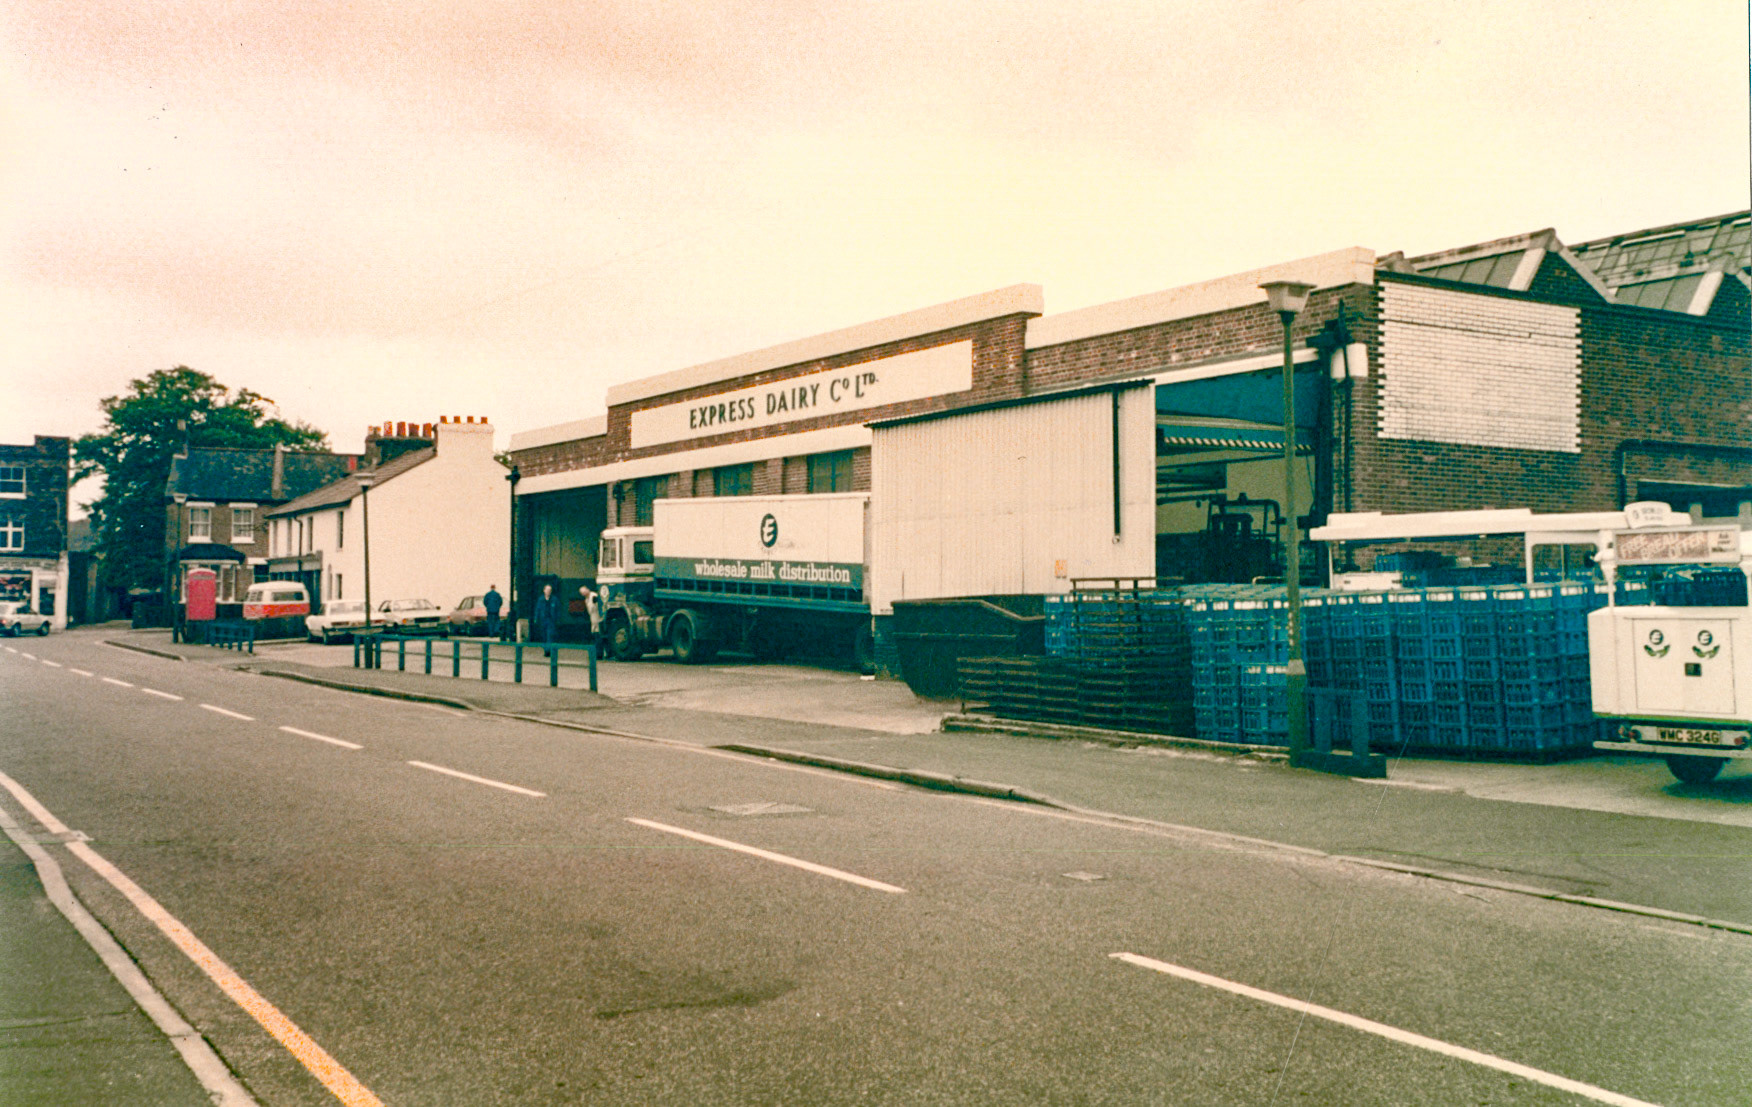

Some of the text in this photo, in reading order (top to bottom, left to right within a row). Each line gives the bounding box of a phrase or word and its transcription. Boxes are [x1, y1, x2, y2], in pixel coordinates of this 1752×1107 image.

[690, 397, 755, 429] EXPRESS
[766, 383, 820, 415] DAIRY
[695, 559, 850, 583] wholesale milk distribution
[1660, 729, 1720, 743] WMC 324G
